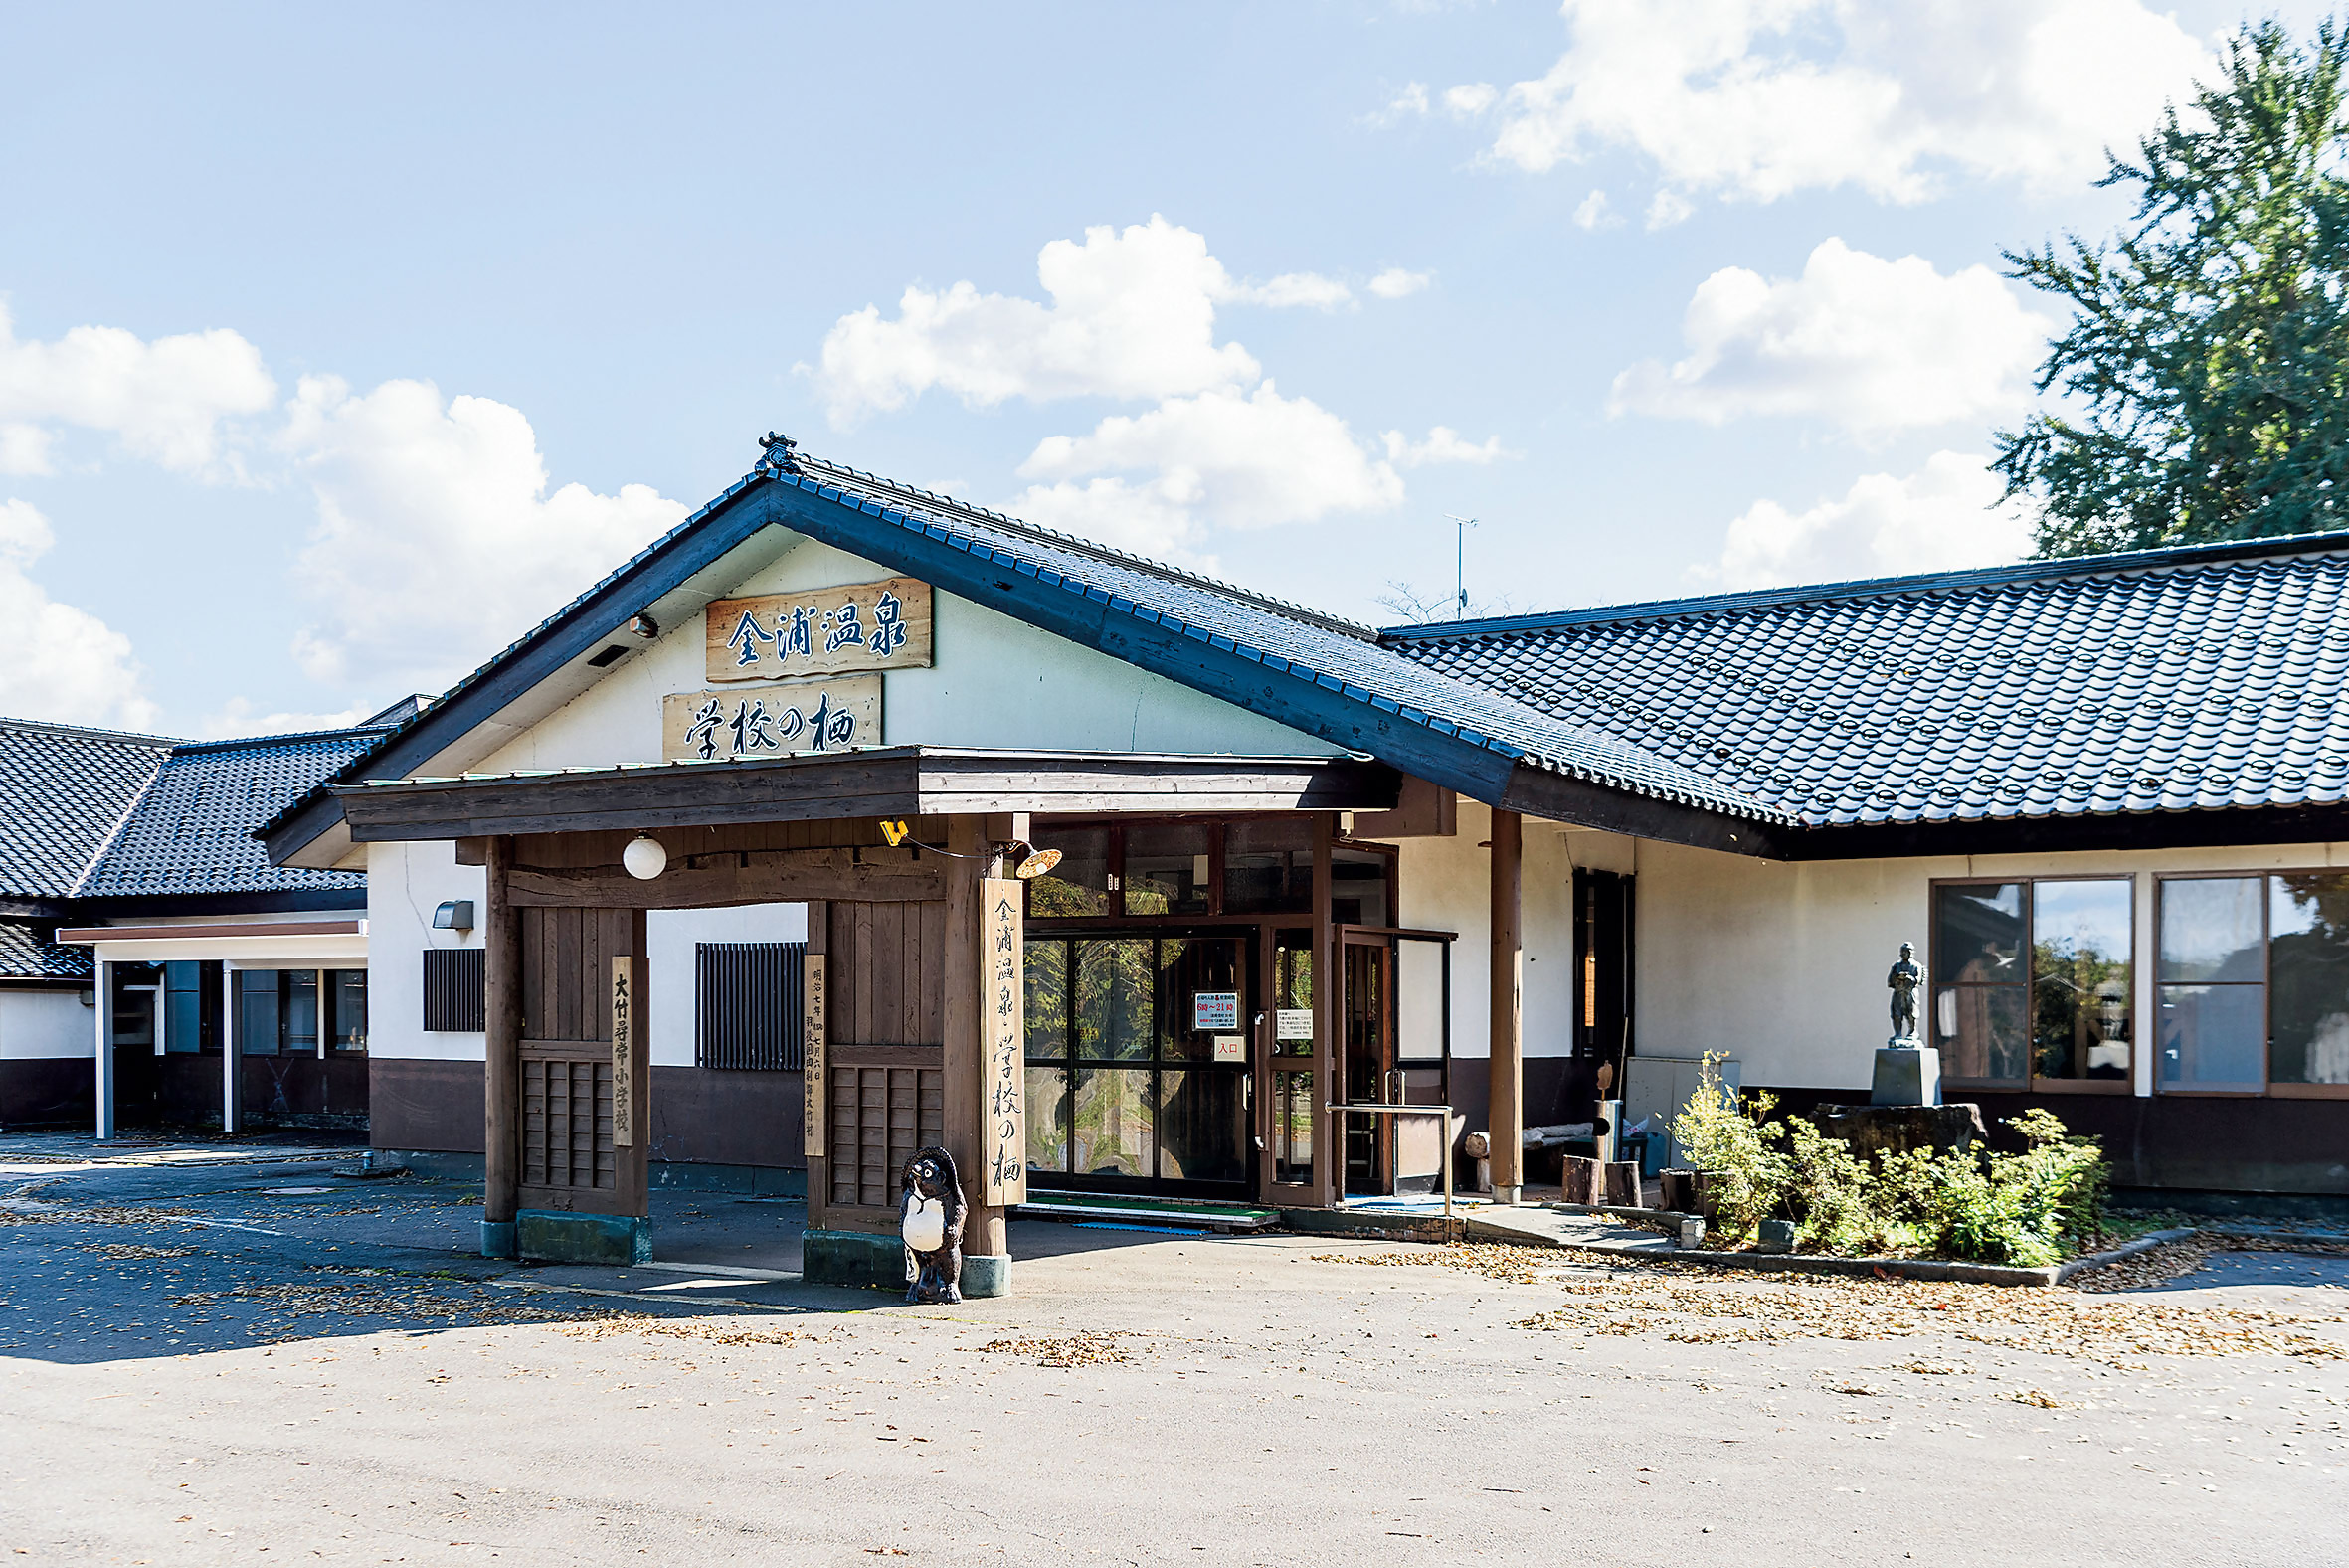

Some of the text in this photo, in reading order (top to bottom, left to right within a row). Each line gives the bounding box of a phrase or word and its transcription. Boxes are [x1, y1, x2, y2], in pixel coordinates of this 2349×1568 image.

[727, 591, 908, 667] 金浦温泉
[684, 690, 857, 759] 学校の栖
[1218, 1043, 1238, 1054] 入口
